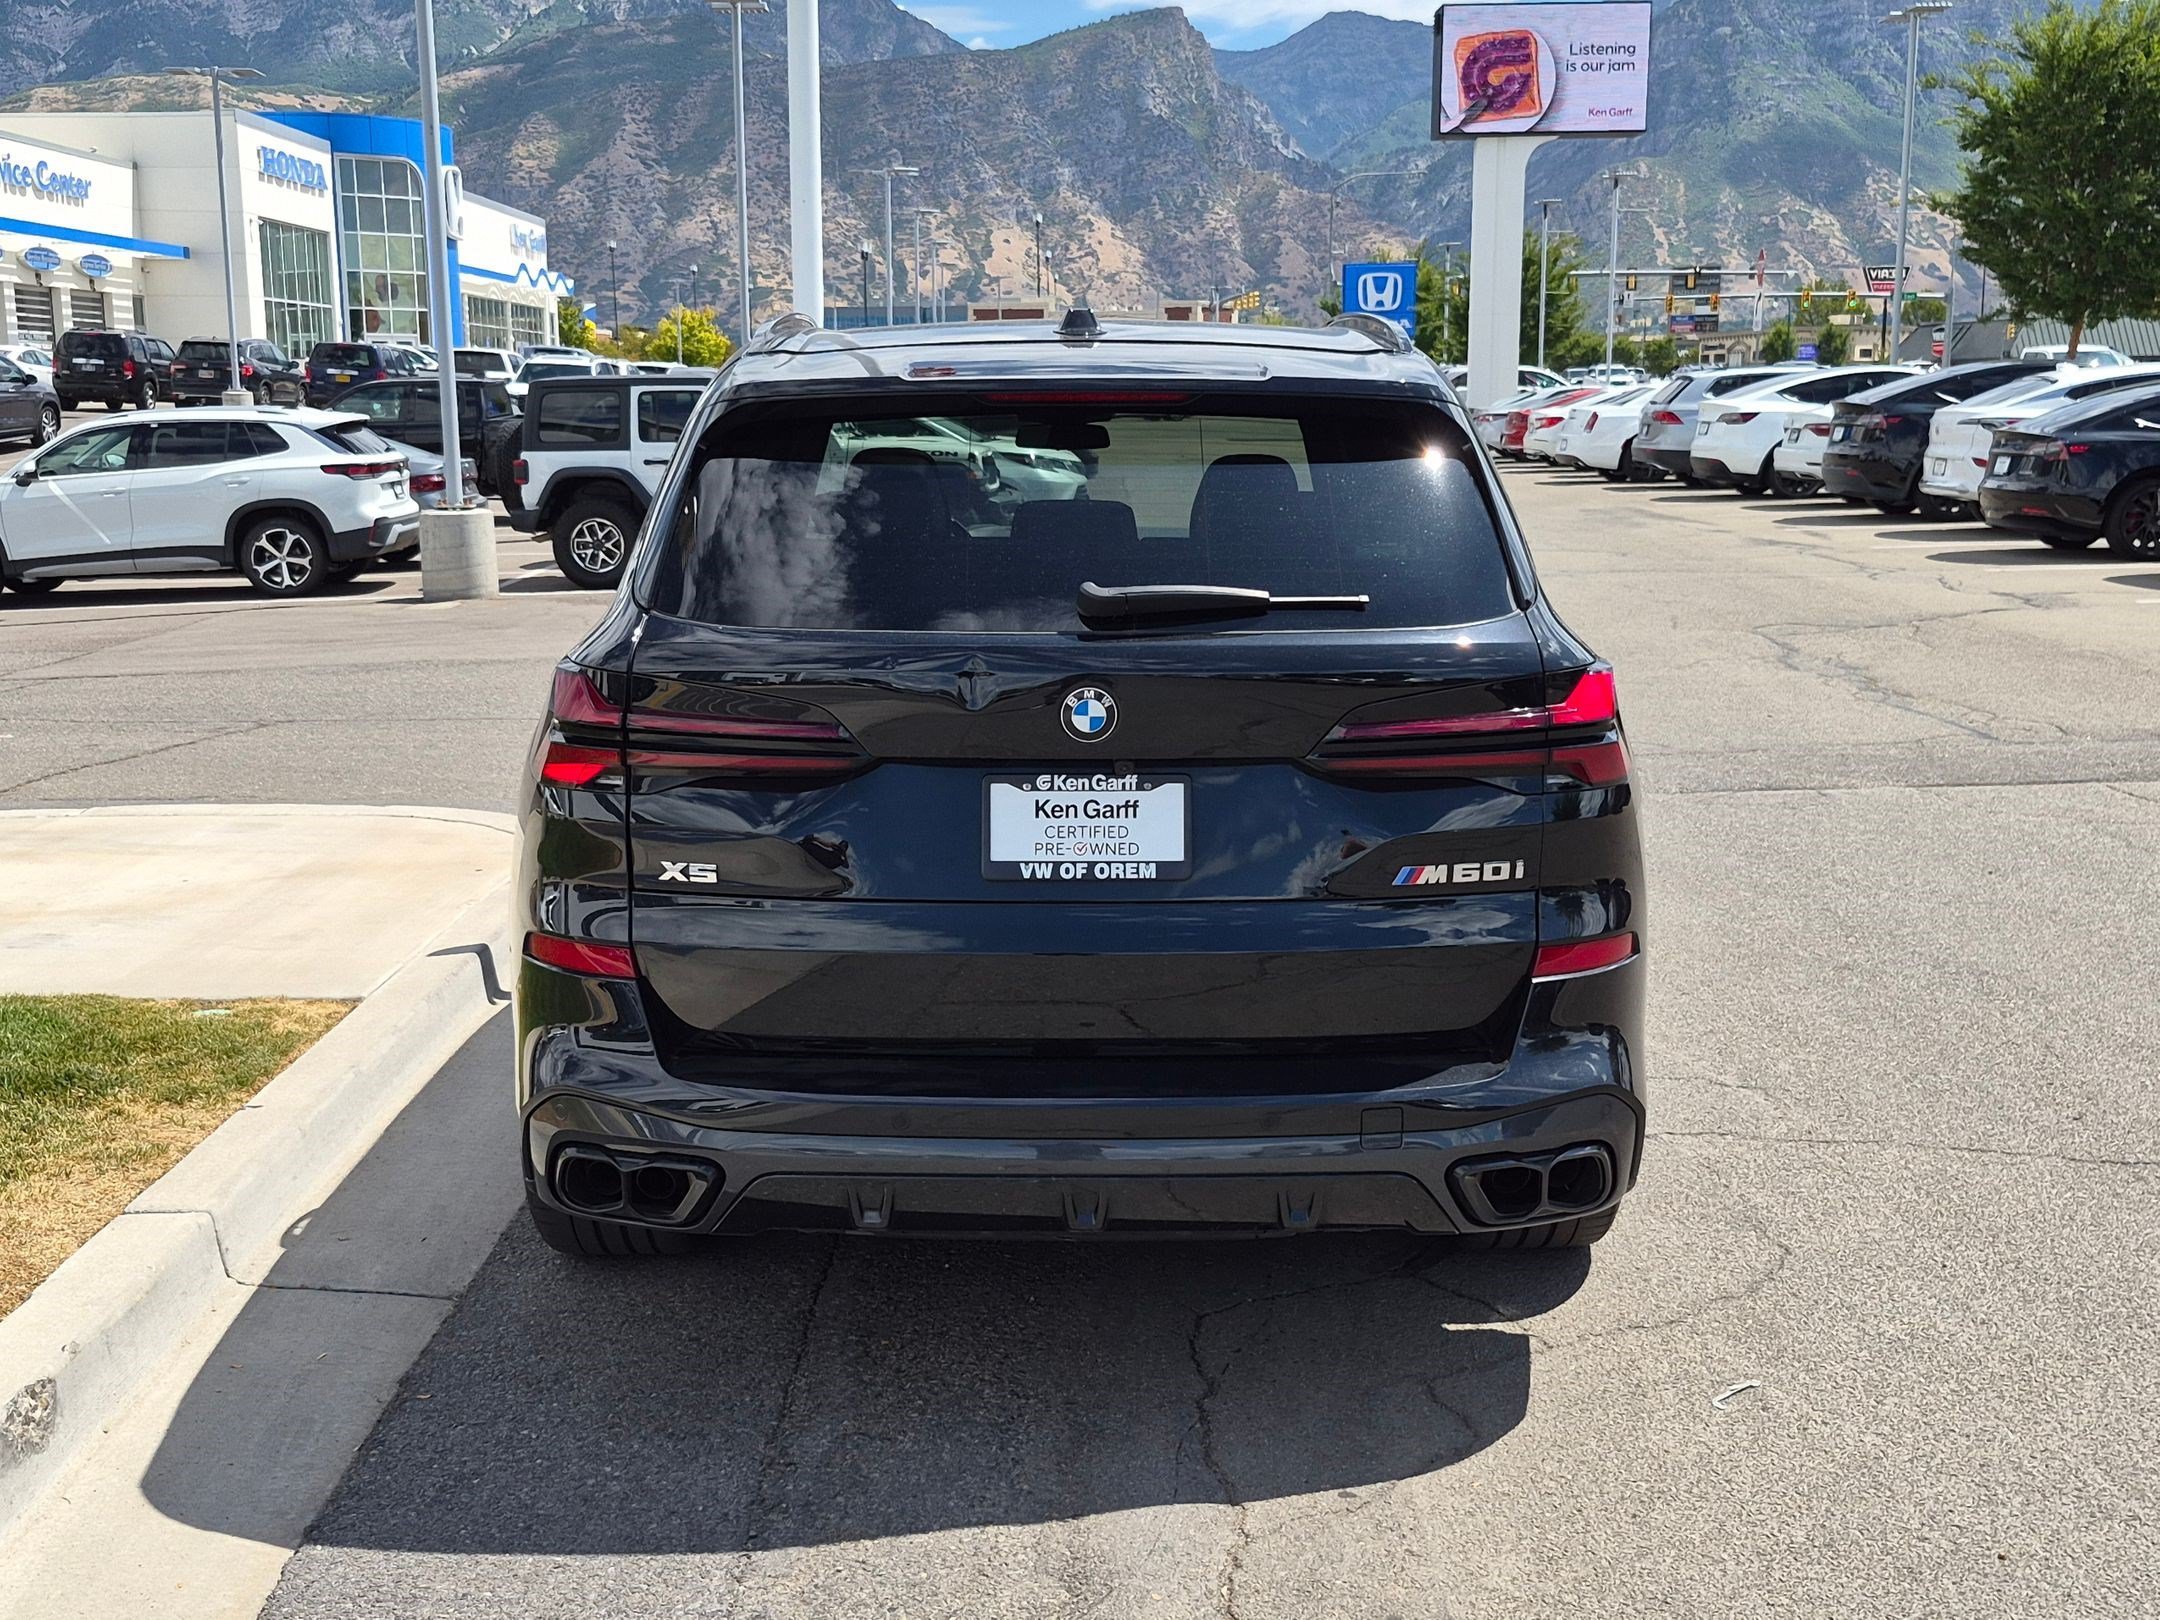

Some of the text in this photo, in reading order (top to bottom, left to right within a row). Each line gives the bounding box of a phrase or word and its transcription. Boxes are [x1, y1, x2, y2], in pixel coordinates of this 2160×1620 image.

[1569, 42, 1636, 57] Listening
[1566, 59, 1636, 74] is our jam
[1588, 107, 1633, 117] Ken Garff
[0, 153, 91, 199] vice Center
[258, 145, 328, 191] HONDA
[1066, 689, 1112, 708] BMW
[1053, 774, 1138, 791] Ken Garff
[1034, 799, 1140, 819] Ken Garff
[1044, 825, 1130, 839] CERTIFIED
[658, 860, 718, 883] X5
[1019, 862, 1157, 879] VW OF OREM
